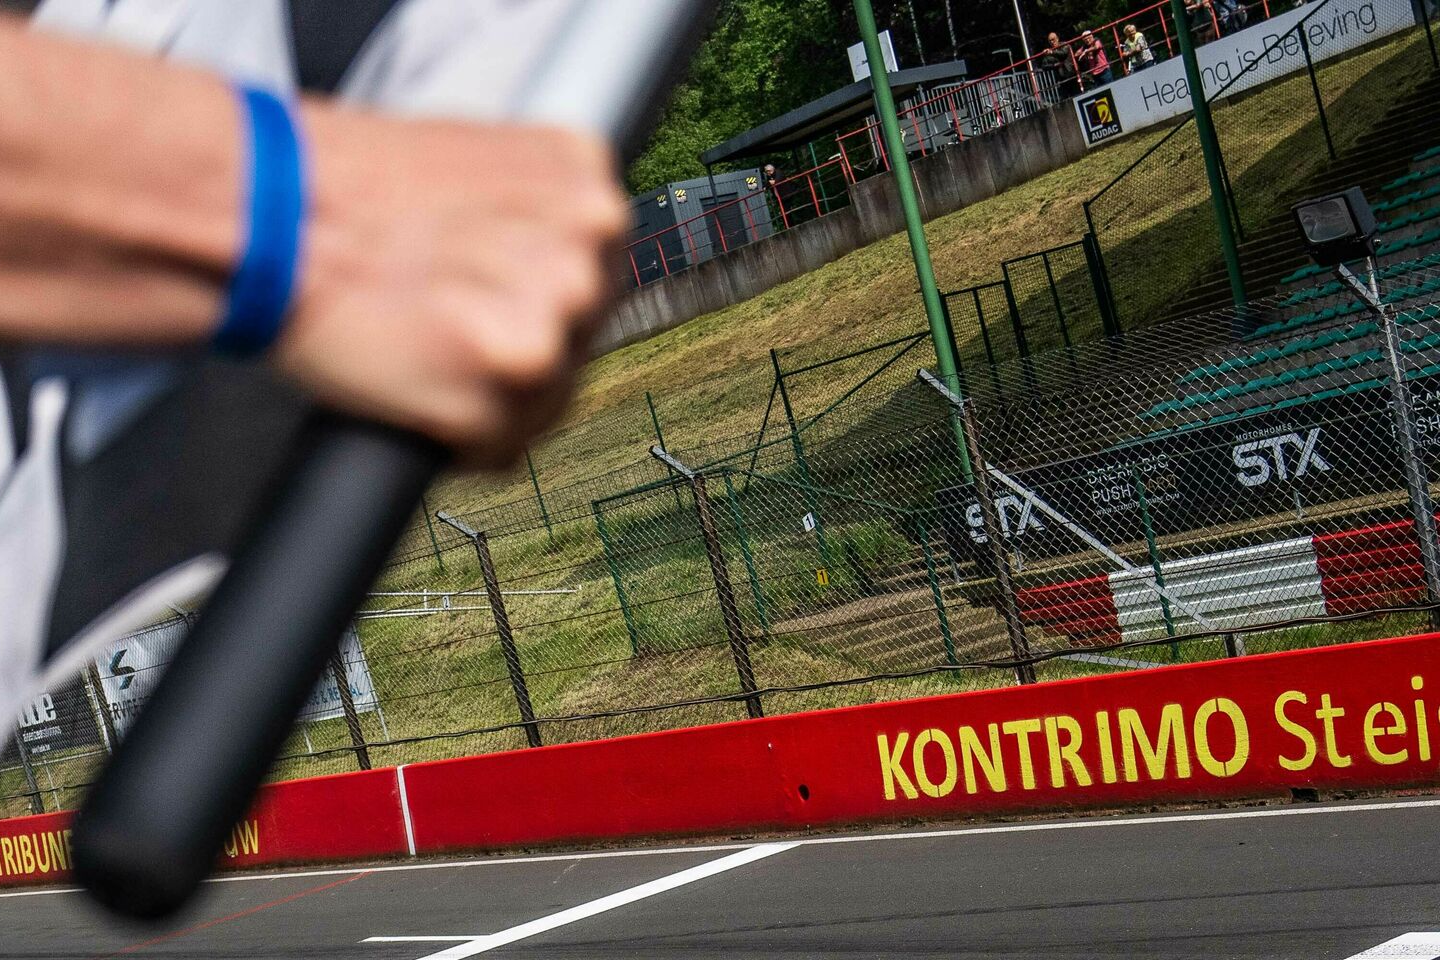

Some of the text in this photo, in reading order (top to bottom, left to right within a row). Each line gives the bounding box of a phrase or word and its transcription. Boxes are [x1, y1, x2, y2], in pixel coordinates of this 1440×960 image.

[1140, 2, 1377, 112] Heang is Beeving
[1091, 124, 1119, 142] AUDAC
[1232, 427, 1331, 487] STX
[1091, 483, 1132, 504] PUSH
[805, 515, 813, 528] 1
[819, 570, 826, 584] 1
[877, 675, 1440, 801] KONTRIMO Stei
